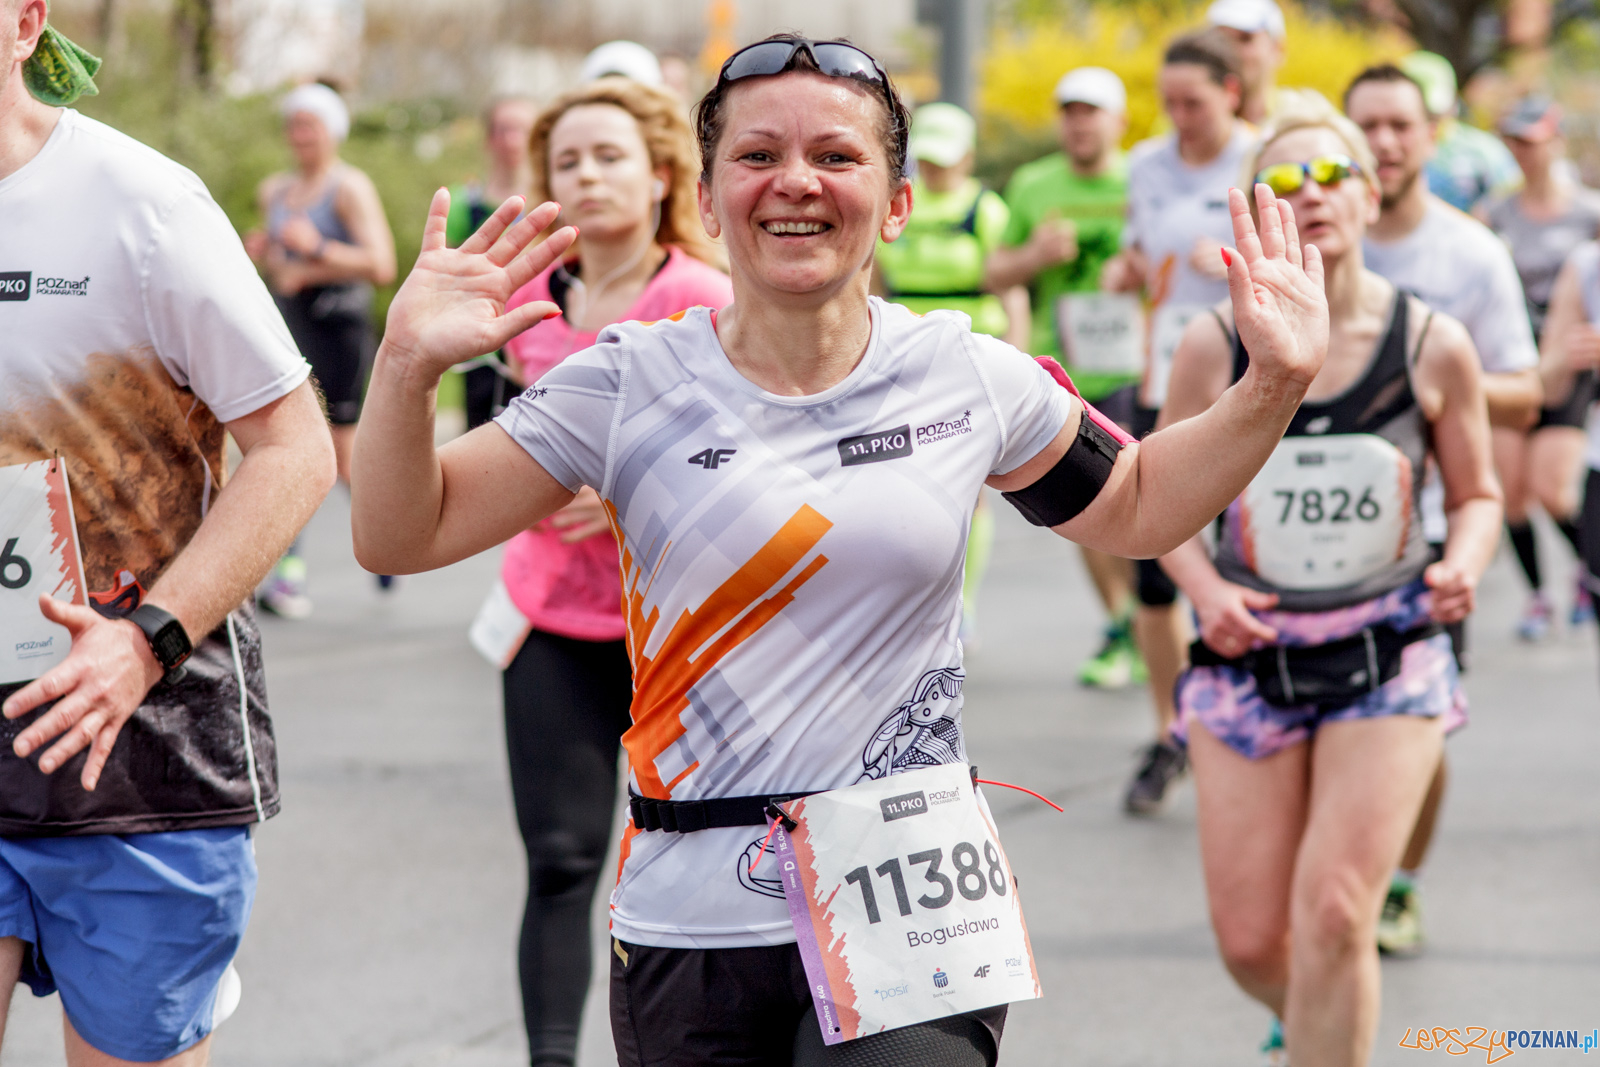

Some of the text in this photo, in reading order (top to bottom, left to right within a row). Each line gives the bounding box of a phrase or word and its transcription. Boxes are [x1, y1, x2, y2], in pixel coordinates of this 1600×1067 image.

[687, 448, 737, 470] 4F
[1273, 485, 1381, 524] 7826
[0, 537, 32, 589] 6
[784, 861, 796, 872] D
[844, 839, 1007, 925] 11388
[906, 917, 1000, 948] Bogusława
[973, 964, 991, 978] 4F
